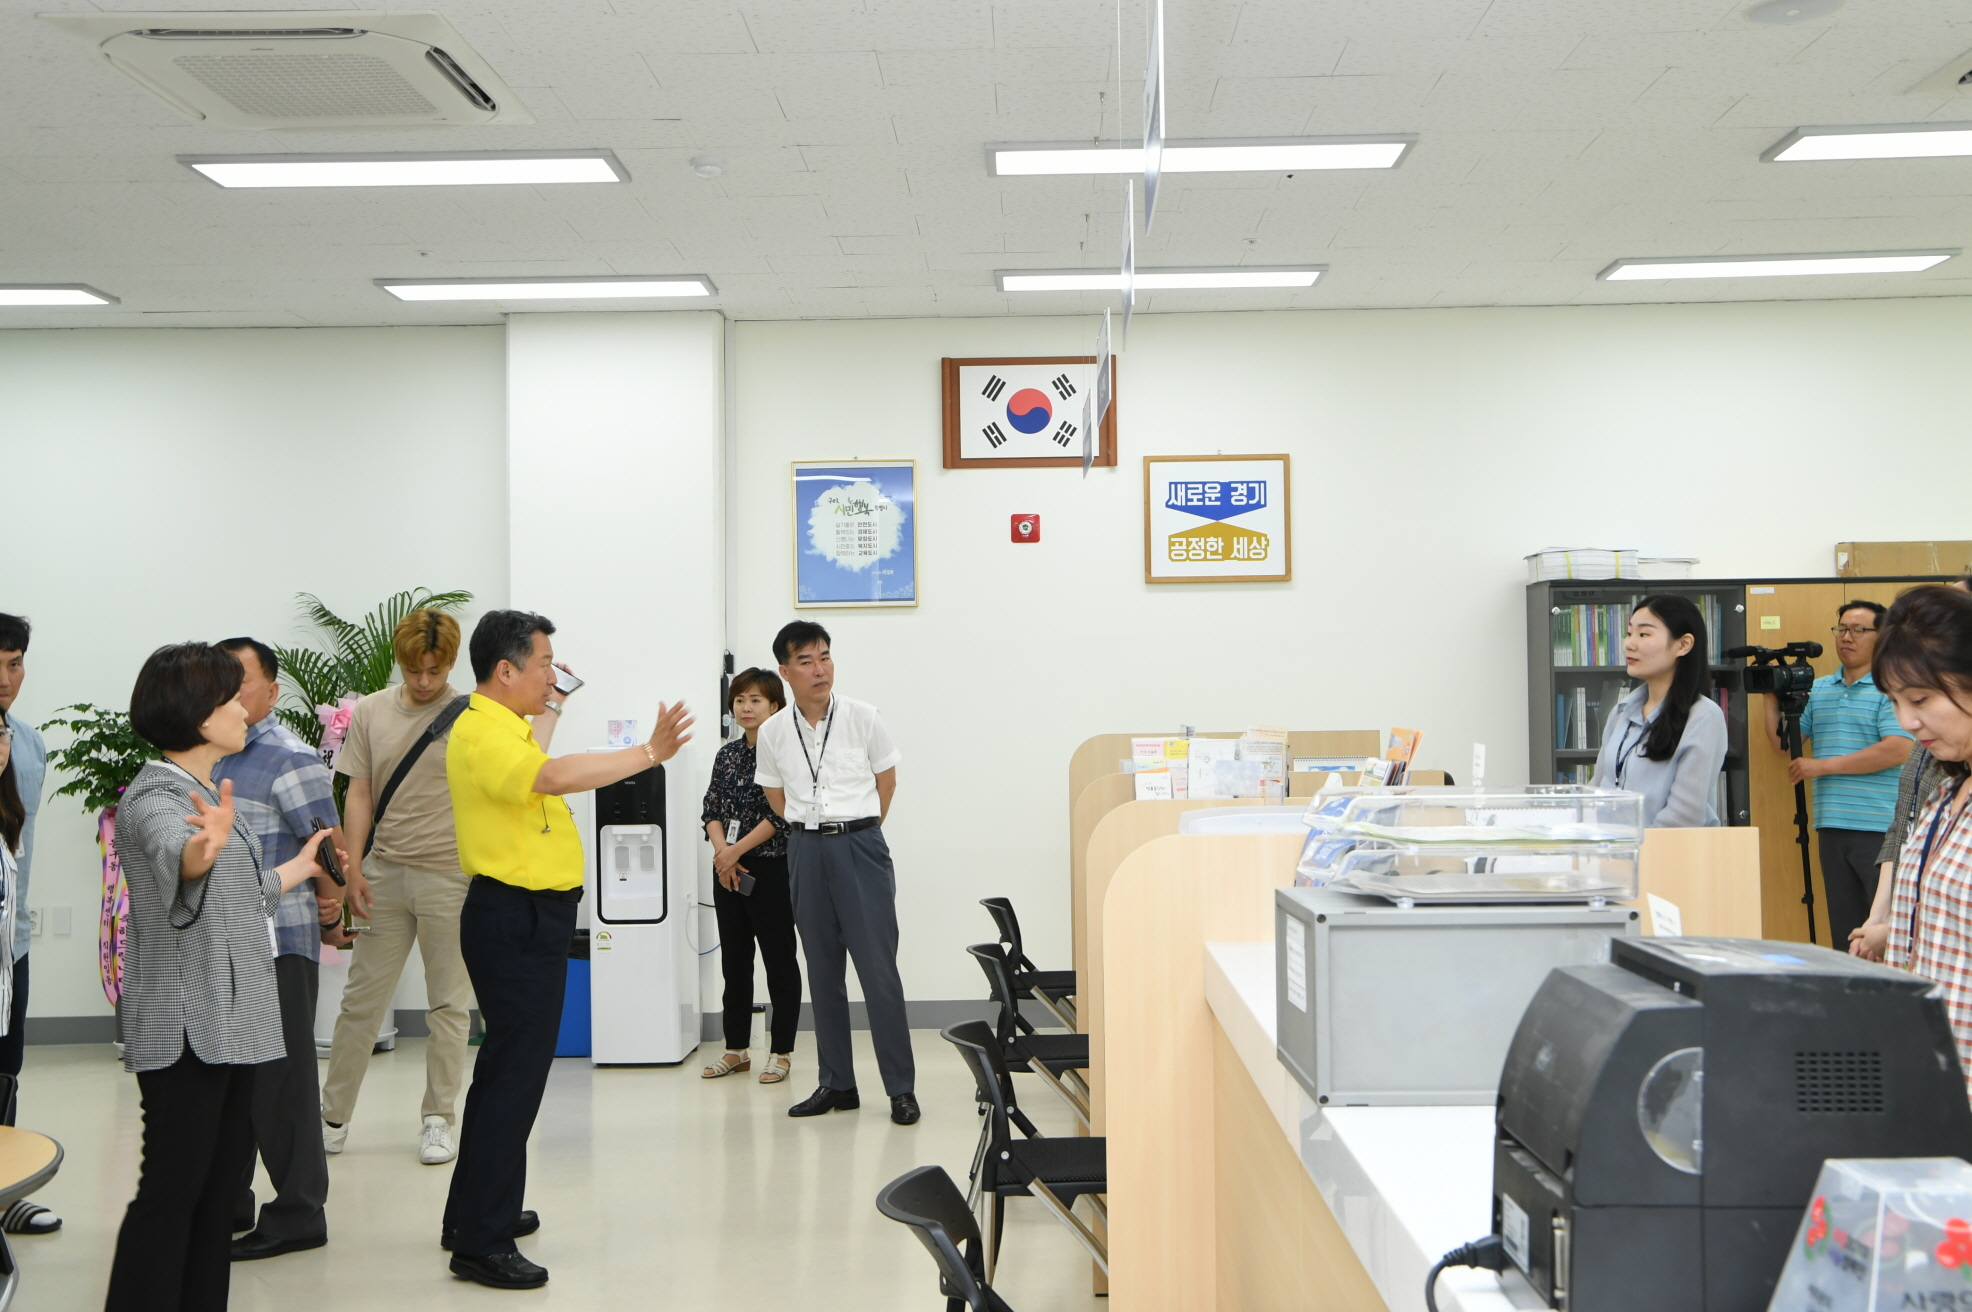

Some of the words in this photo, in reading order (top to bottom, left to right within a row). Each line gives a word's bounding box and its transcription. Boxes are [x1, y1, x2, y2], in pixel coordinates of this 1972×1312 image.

[1168, 482, 1221, 506] 새로운
[1230, 482, 1265, 506] 경기
[834, 498, 874, 516] 시민행복
[1170, 536, 1225, 560] 공정한
[1230, 536, 1268, 560] 세상
[322, 749, 334, 770] 祝
